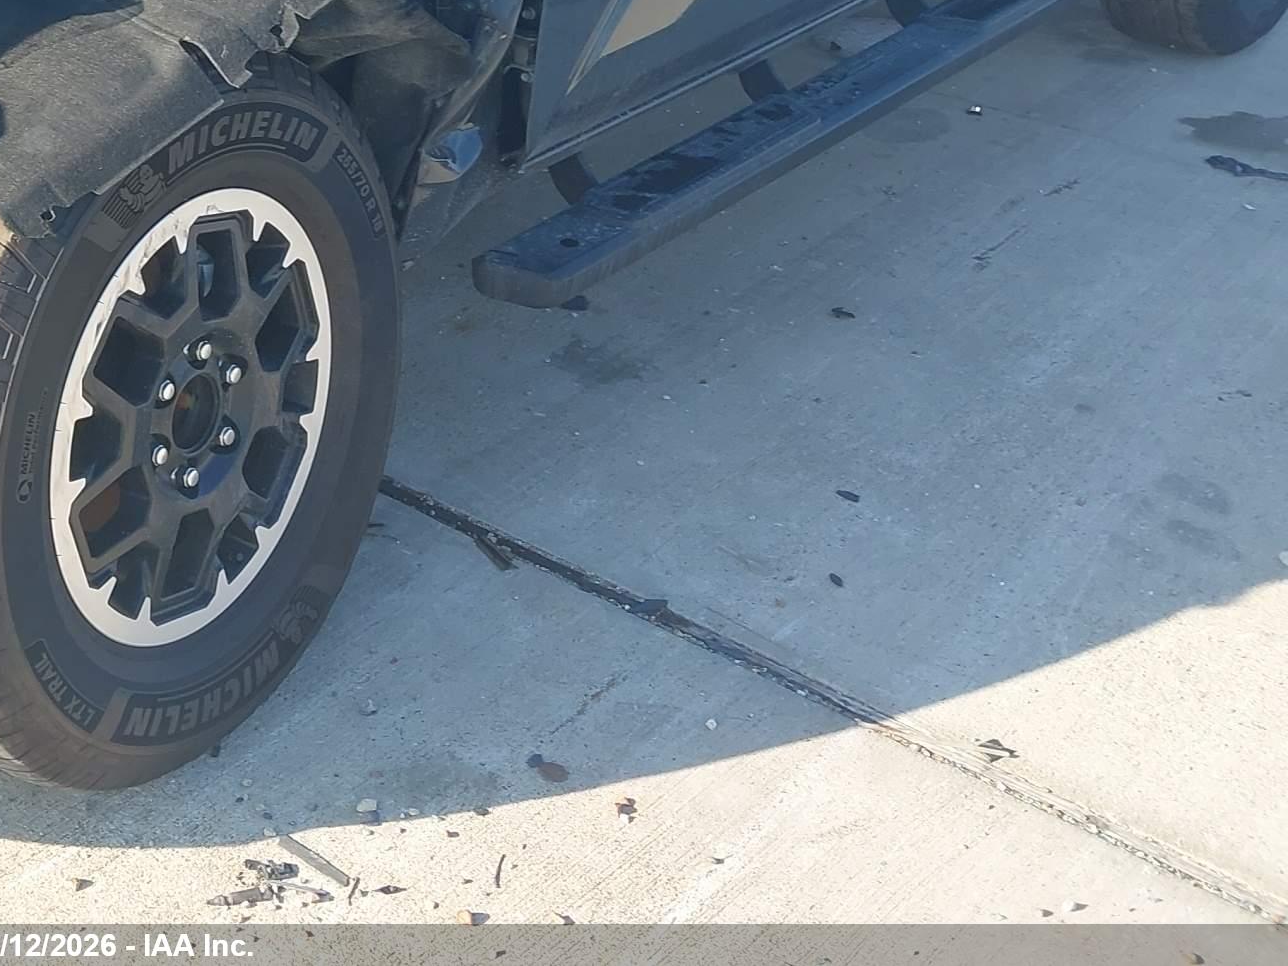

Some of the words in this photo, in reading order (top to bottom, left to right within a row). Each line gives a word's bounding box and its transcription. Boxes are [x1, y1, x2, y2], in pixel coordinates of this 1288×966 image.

[168, 110, 319, 175] MICHELIN
[20, 413, 35, 475] MICHELIN
[34, 652, 68, 702] TRAIL
[124, 640, 280, 736] MICHELIN
[63, 694, 96, 726] LTX
